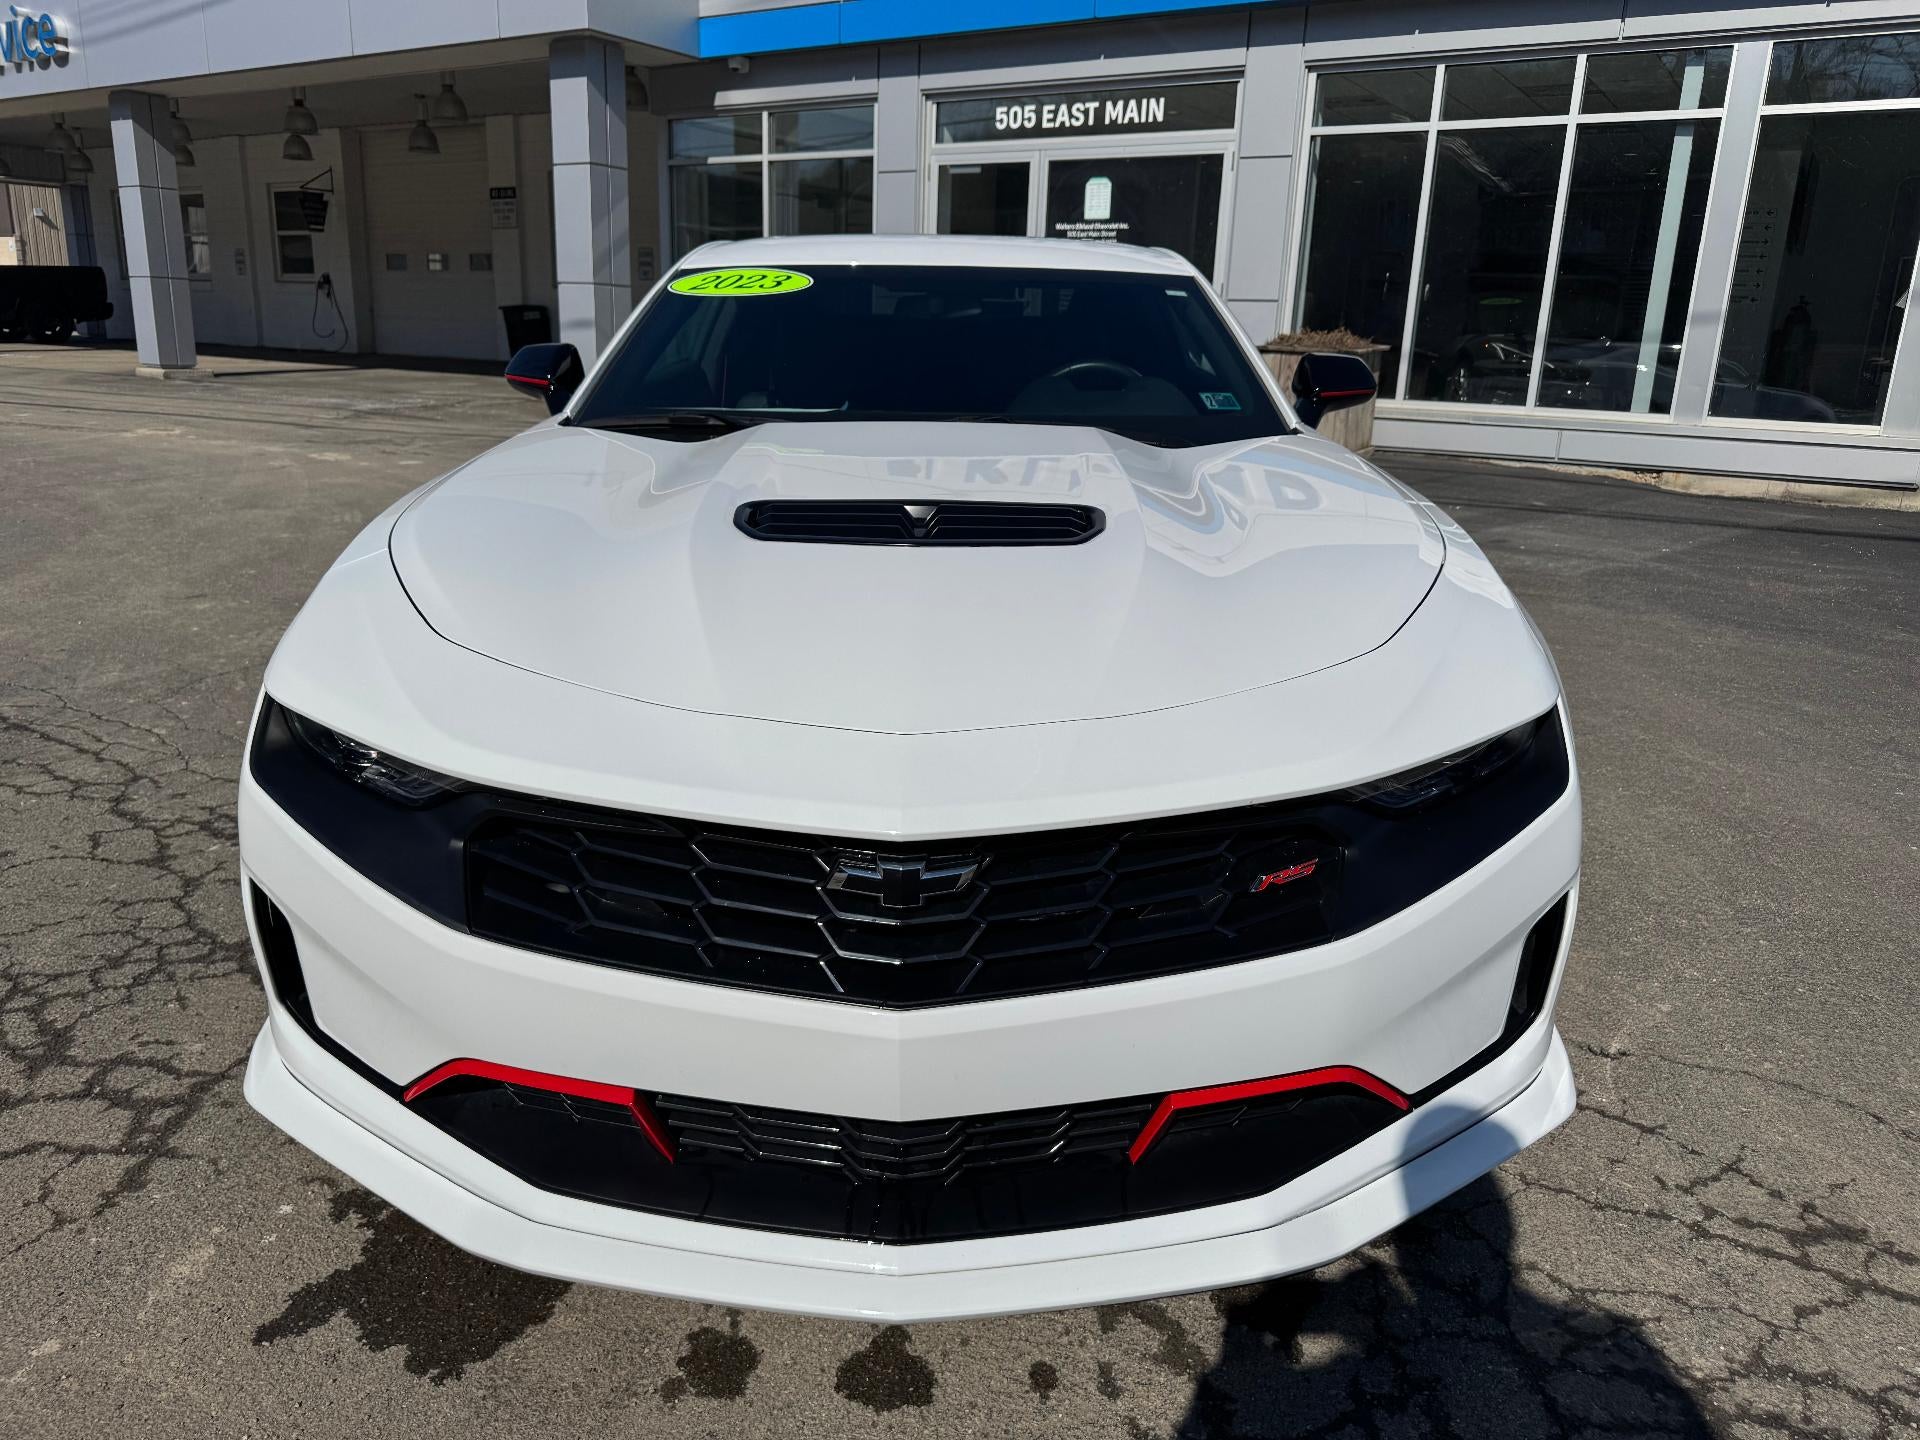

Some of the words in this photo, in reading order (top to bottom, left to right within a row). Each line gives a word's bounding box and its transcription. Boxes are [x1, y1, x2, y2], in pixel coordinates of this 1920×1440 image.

[994, 105, 1036, 131] 505
[1041, 101, 1099, 129] EAST
[1104, 97, 1165, 125] MAIN
[687, 274, 793, 291] 2023
[1250, 858, 1319, 893] RS
